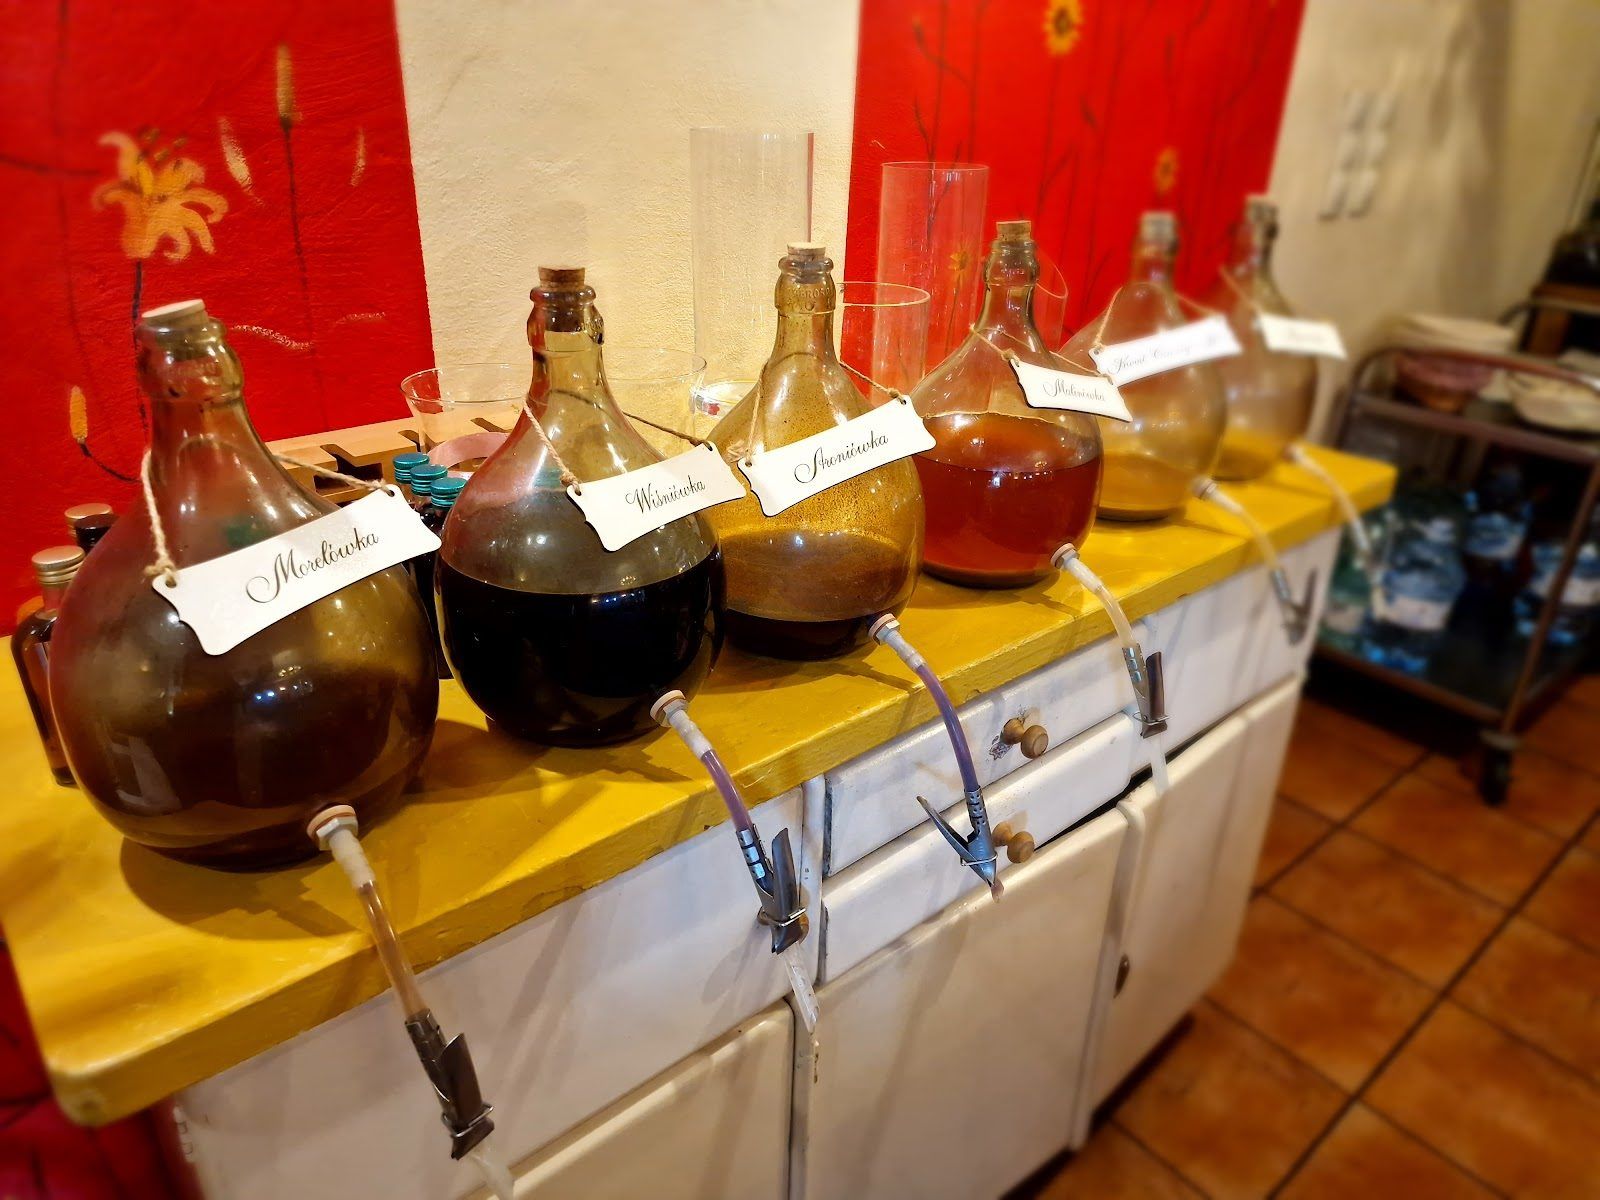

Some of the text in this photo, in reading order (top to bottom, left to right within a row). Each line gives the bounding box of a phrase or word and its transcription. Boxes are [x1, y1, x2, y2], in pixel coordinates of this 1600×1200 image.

[793, 429, 889, 484] Aroniówka
[625, 474, 706, 515] Wiśniówka
[245, 527, 380, 604] Morelówka
